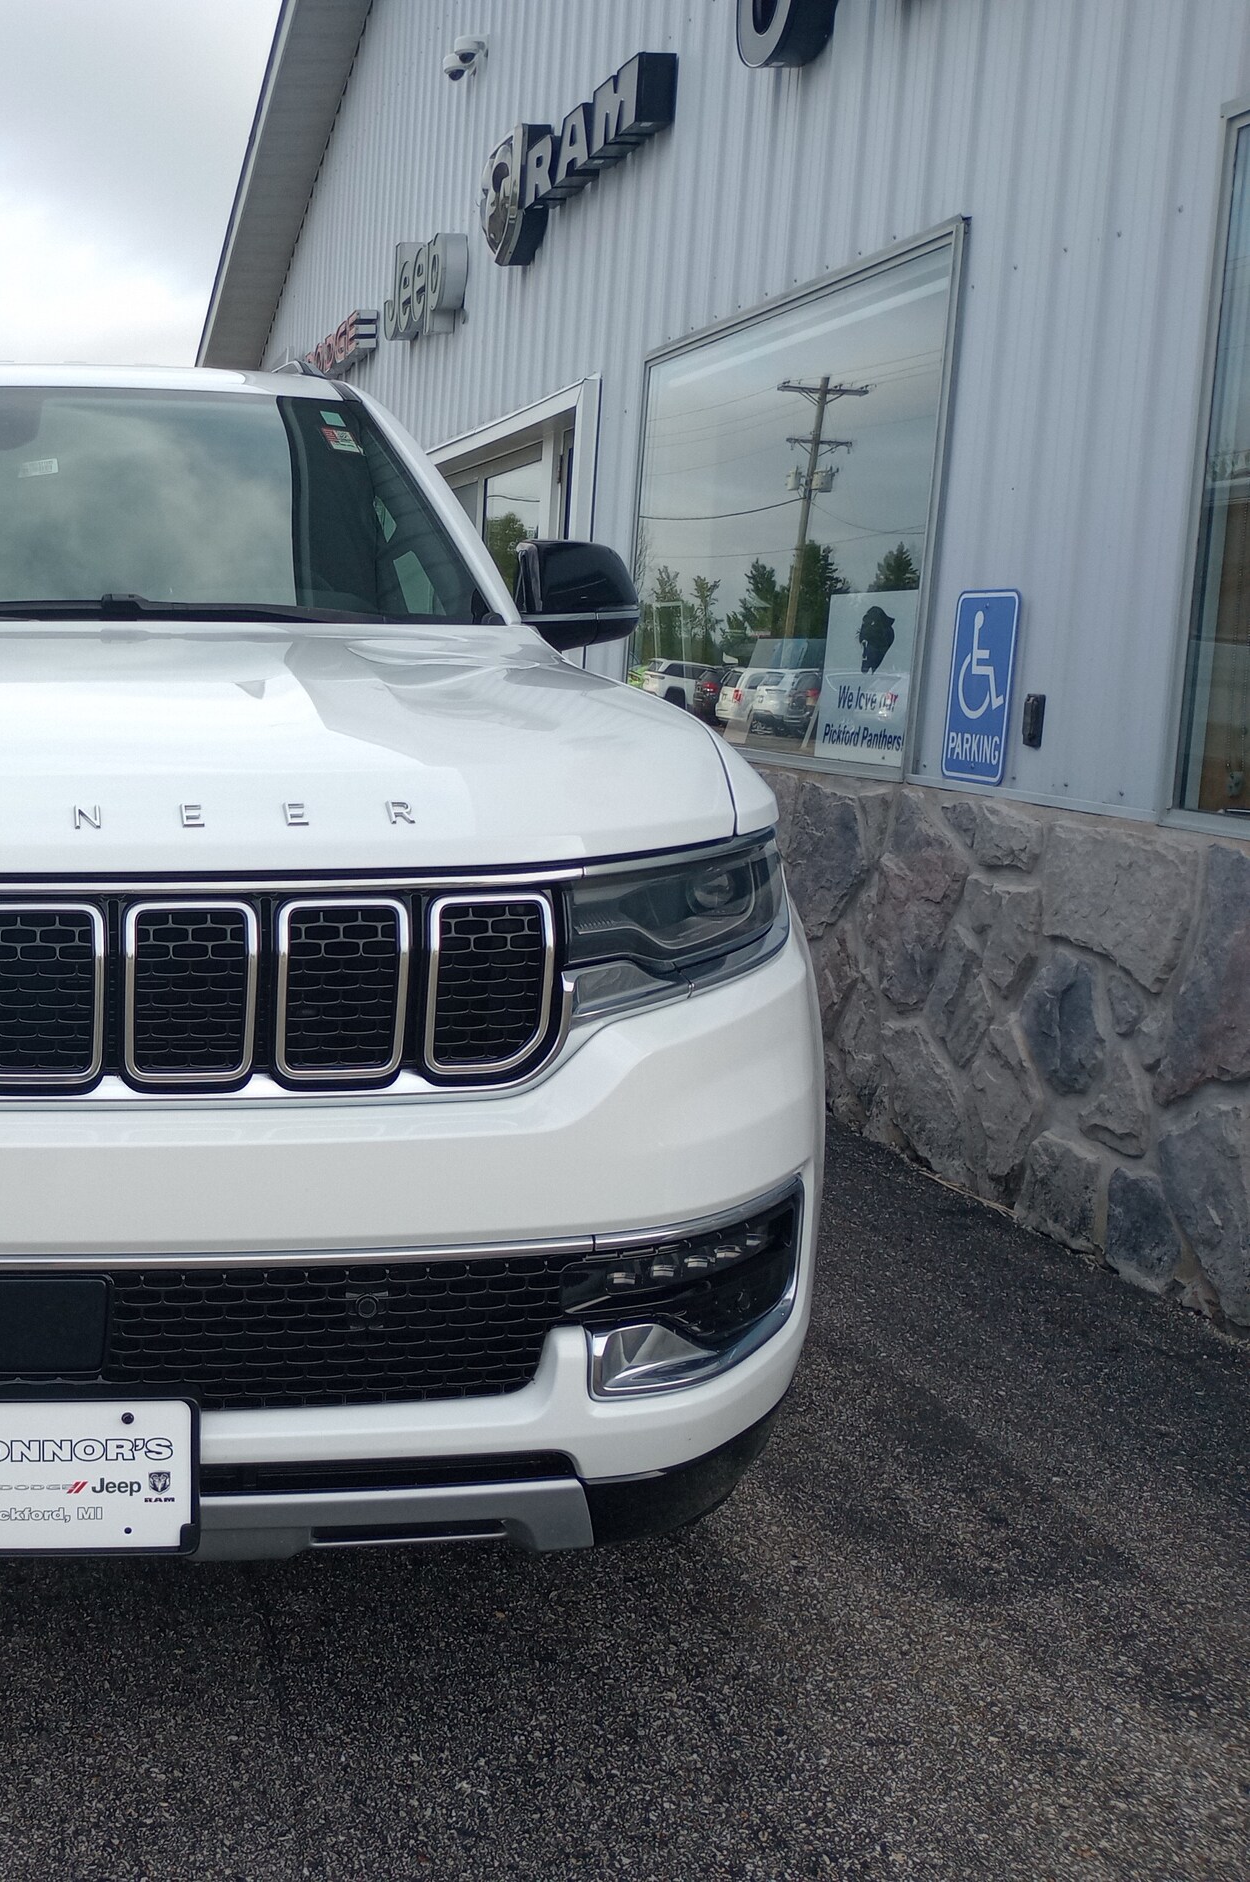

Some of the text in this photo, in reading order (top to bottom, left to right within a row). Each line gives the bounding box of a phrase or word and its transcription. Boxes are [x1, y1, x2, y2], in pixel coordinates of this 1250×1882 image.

[523, 53, 647, 211] RAM
[383, 233, 454, 341] Jeep
[837, 685, 853, 710] We
[822, 723, 905, 752] Pickford Panthers!
[948, 731, 1000, 766] PARKING
[91, 1477, 142, 1497] Jeep
[77, 1507, 103, 1520] MI
